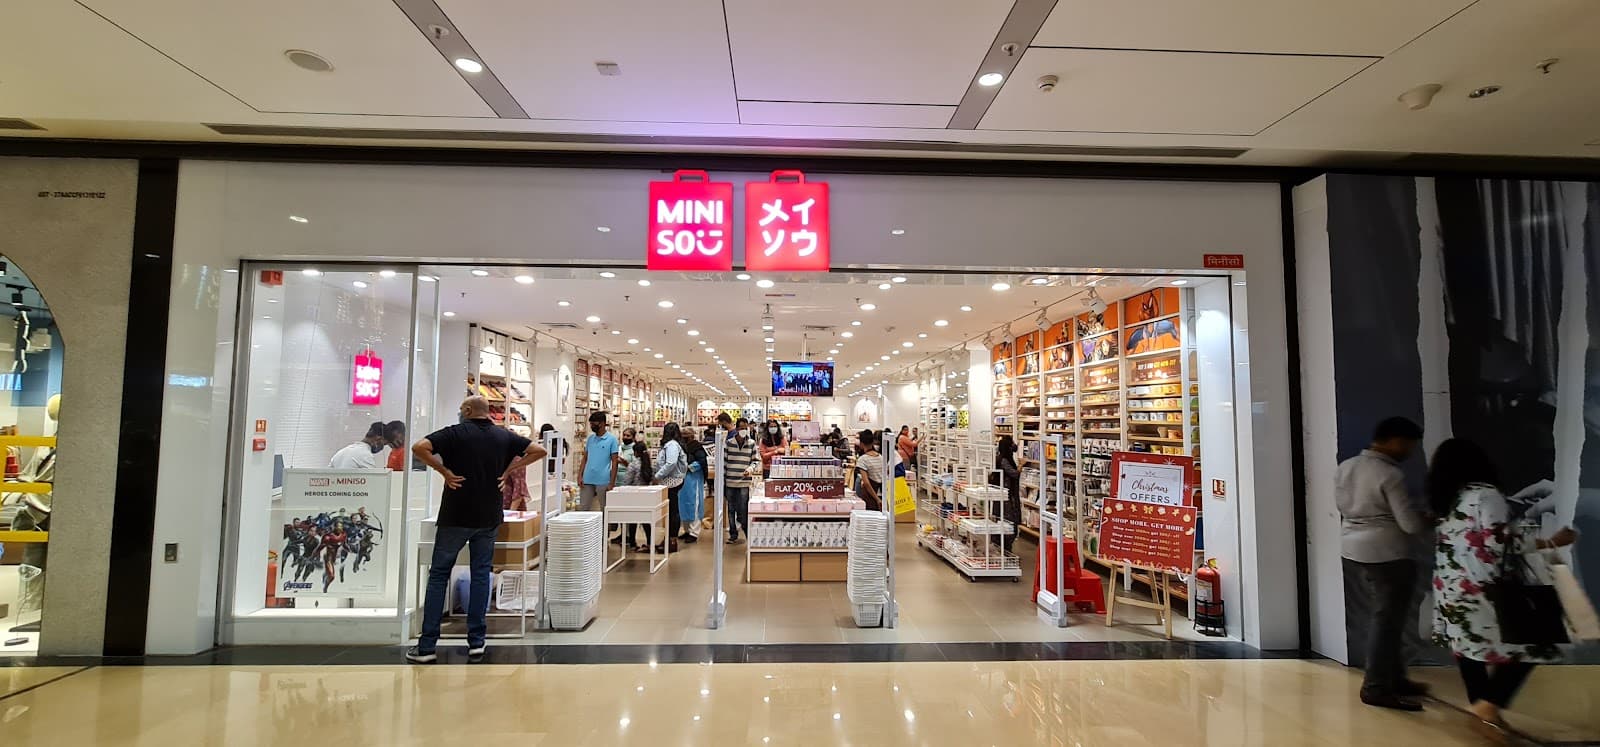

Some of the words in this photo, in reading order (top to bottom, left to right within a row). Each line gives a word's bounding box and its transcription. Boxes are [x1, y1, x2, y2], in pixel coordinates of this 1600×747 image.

[657, 199, 724, 225] MINI
[758, 198, 816, 226] メイ
[762, 229, 818, 257] ソウ
[336, 477, 367, 486] MINISO
[793, 482, 815, 493] 20%
[1131, 478, 1169, 493] Christmas
[1129, 492, 1170, 504] OFFERS
[1111, 517, 1129, 525] SHOP
[1165, 524, 1184, 532] MORE
